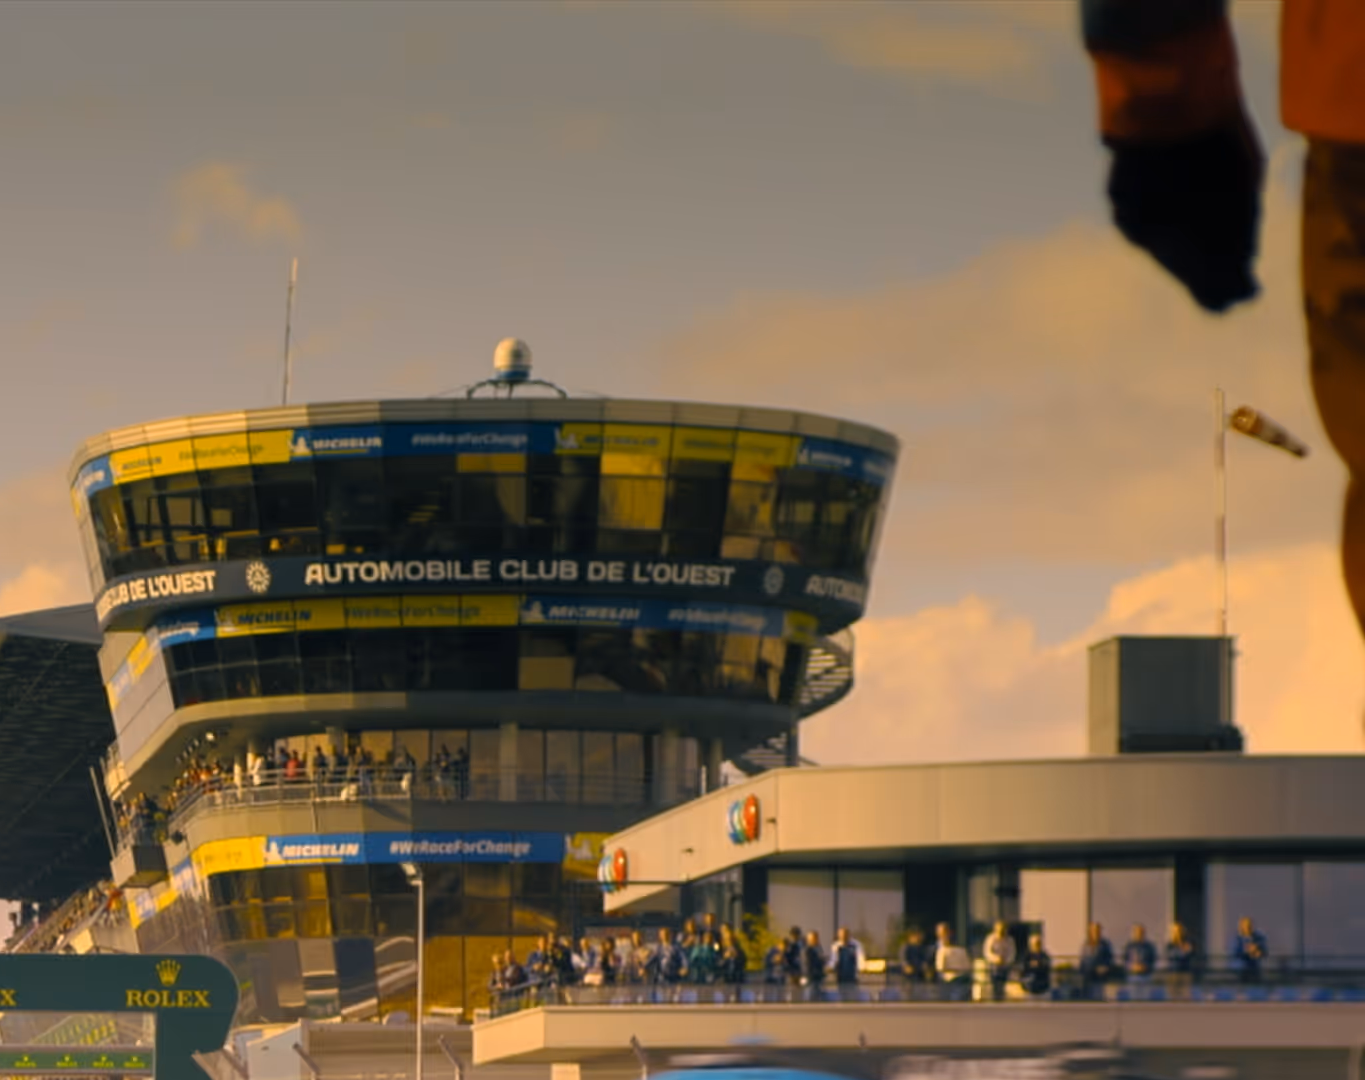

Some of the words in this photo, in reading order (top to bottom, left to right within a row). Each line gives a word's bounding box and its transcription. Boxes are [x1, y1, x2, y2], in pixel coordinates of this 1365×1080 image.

[148, 570, 216, 598] L'OUEST
[305, 560, 491, 585] AUTOMOBILE
[499, 560, 578, 581] CLUB
[587, 561, 626, 582] DE
[633, 563, 735, 586] L'OUEST
[282, 843, 360, 858] MICHELIN
[126, 990, 212, 1008] ROLEX
